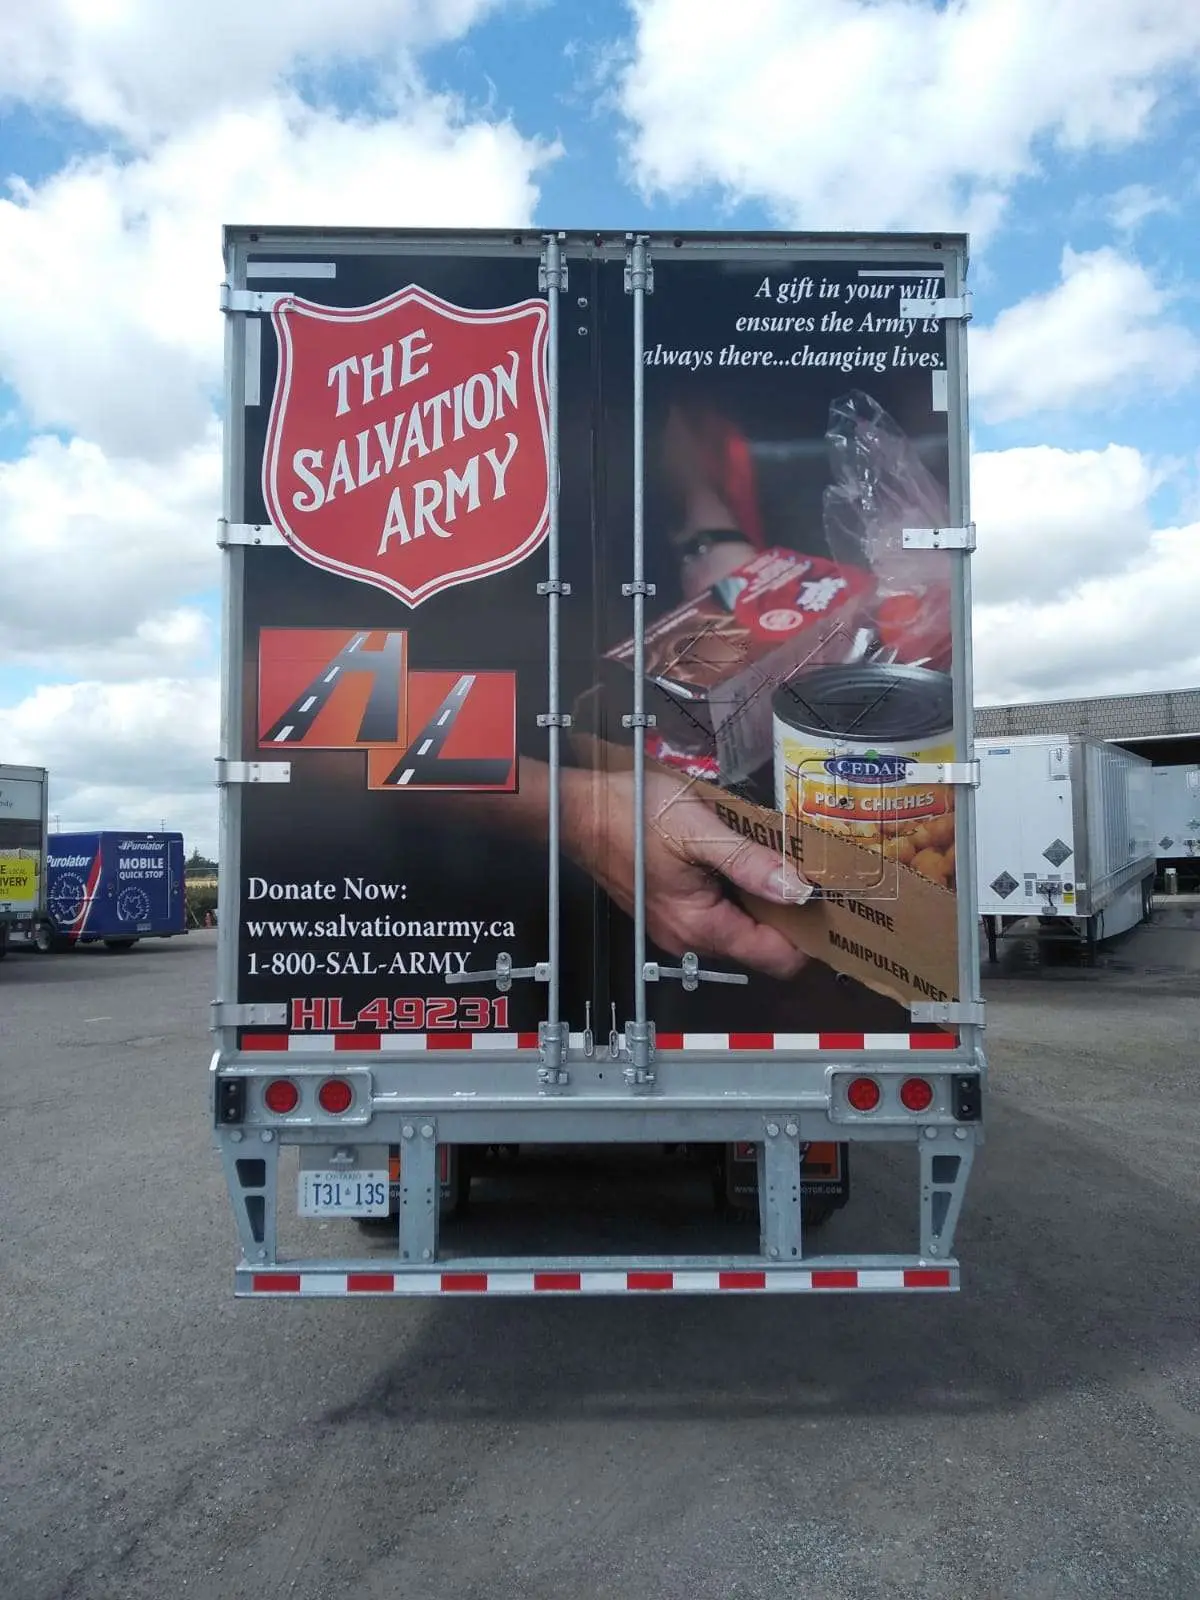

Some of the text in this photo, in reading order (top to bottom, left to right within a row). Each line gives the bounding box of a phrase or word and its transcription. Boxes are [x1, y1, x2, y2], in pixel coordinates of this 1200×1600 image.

[754, 277, 940, 305] A gift in your will
[735, 312, 940, 337] ensures the Army is
[642, 345, 945, 372] always there...changing lives.
[327, 328, 433, 417] THE
[292, 350, 520, 513] SALVATION
[376, 432, 519, 557] ARMY
[837, 760, 907, 777] CEDAR
[860, 791, 935, 812] CHICHES
[128, 842, 164, 851] Purolator
[715, 804, 805, 862] FRAGILE
[47, 855, 92, 868] Purolator
[119, 858, 164, 869] MOBILE
[119, 871, 144, 880] QUICK
[247, 876, 407, 901] Donate Now:
[247, 914, 516, 943] www.salvationarmy.ca
[847, 899, 895, 932] VERRE
[247, 951, 471, 976] 1-800-SAL-ARMY
[828, 930, 948, 1002] MANIPULER AVEC
[289, 996, 510, 1030] HL49231
